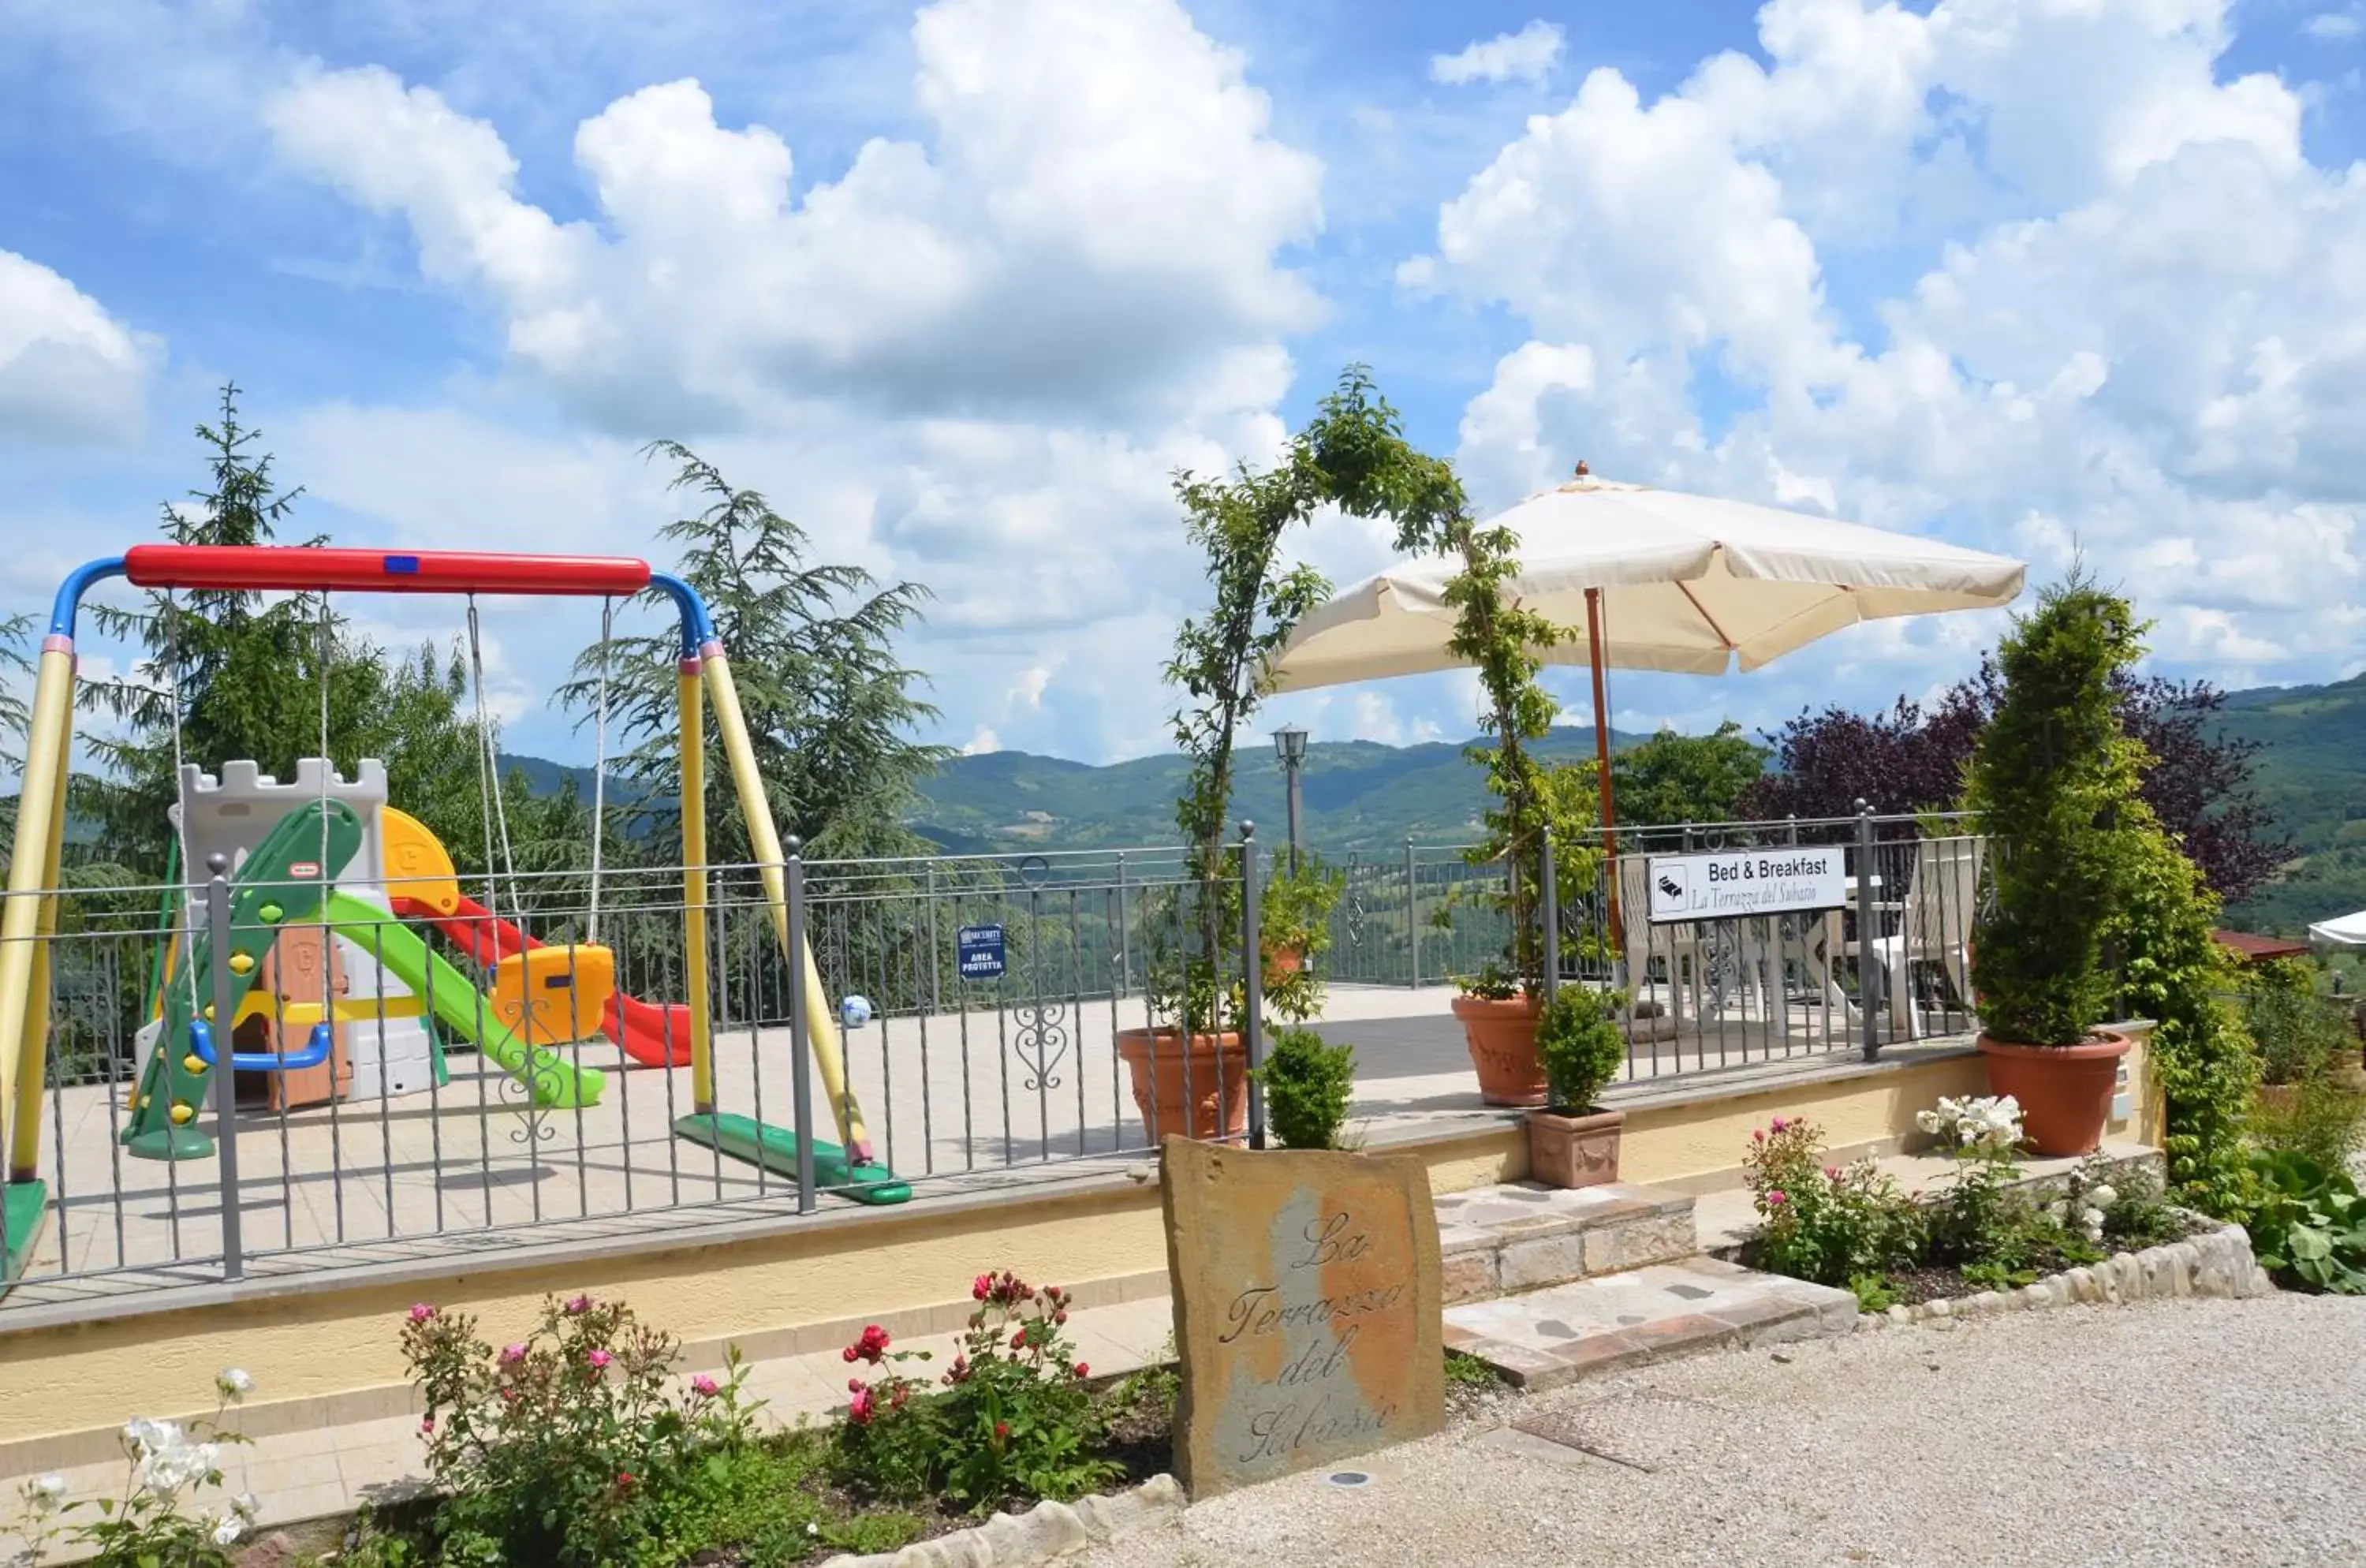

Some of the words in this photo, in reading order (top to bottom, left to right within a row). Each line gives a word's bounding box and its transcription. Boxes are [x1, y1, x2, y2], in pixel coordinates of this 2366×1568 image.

[1692, 889, 1707, 909] La
[1711, 887, 1760, 911] Terrazza
[1761, 882, 1777, 905] del
[1708, 861, 1738, 882] Bed
[1744, 861, 1754, 879] &
[1759, 857, 1827, 878] Breakfast
[1289, 1211, 1369, 1269] La
[1218, 1283, 1406, 1344] Terrazza
[1277, 1323, 1359, 1387] del
